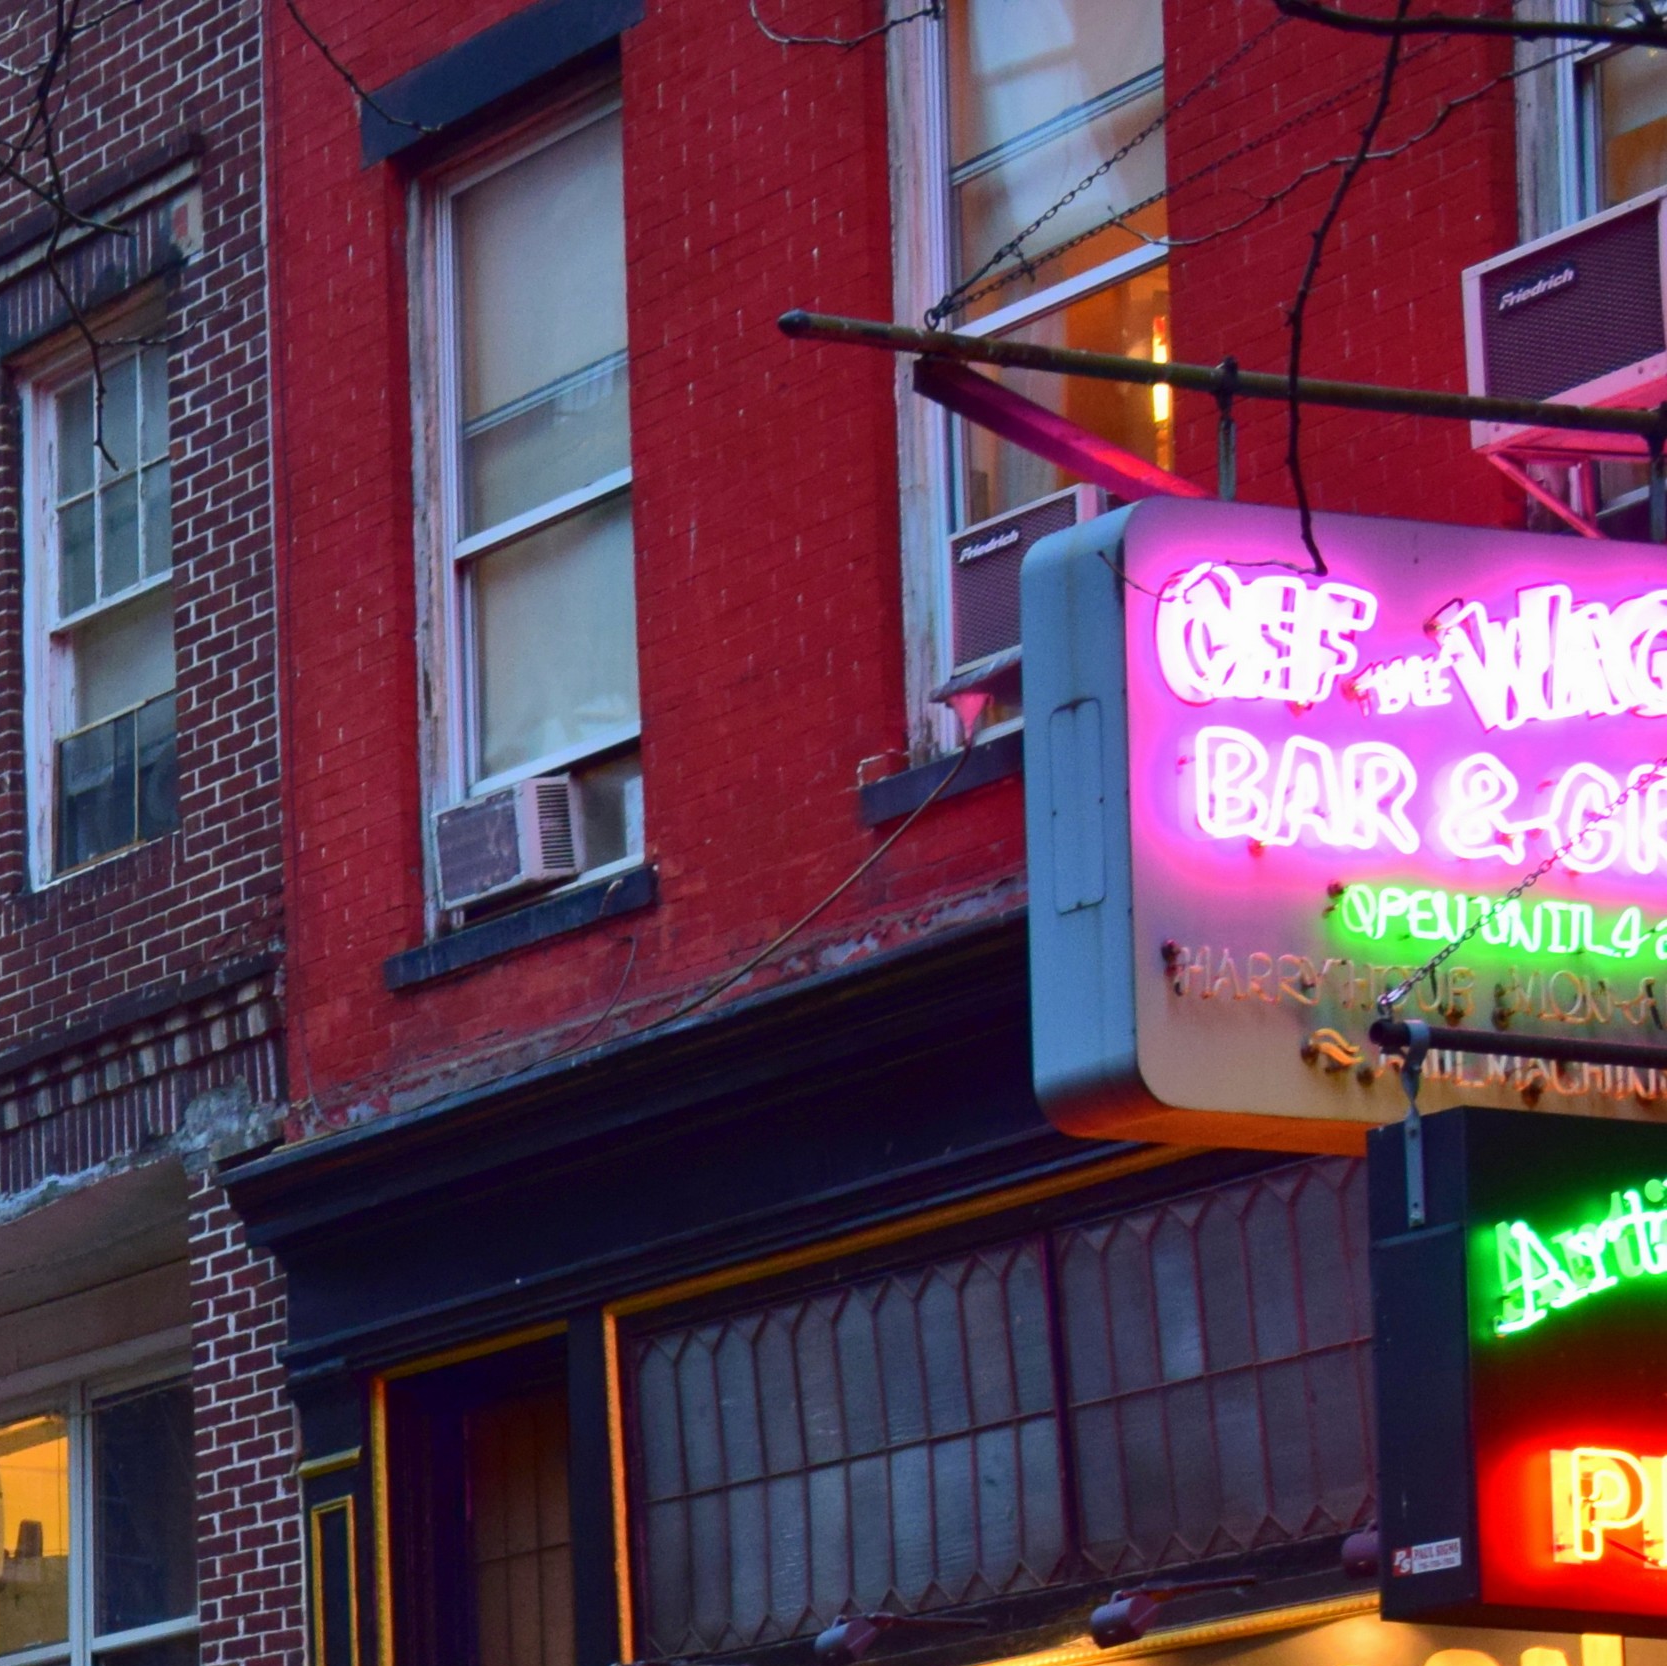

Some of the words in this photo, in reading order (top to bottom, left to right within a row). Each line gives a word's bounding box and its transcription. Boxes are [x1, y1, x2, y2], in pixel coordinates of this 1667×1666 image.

[1499, 267, 1574, 311] Friedrich
[959, 530, 1019, 563] Friedrich
[1155, 562, 1378, 708] OFF
[1192, 724, 1420, 855] BAR
[1438, 751, 1526, 866] &
[1341, 883, 1466, 943] OPEN
